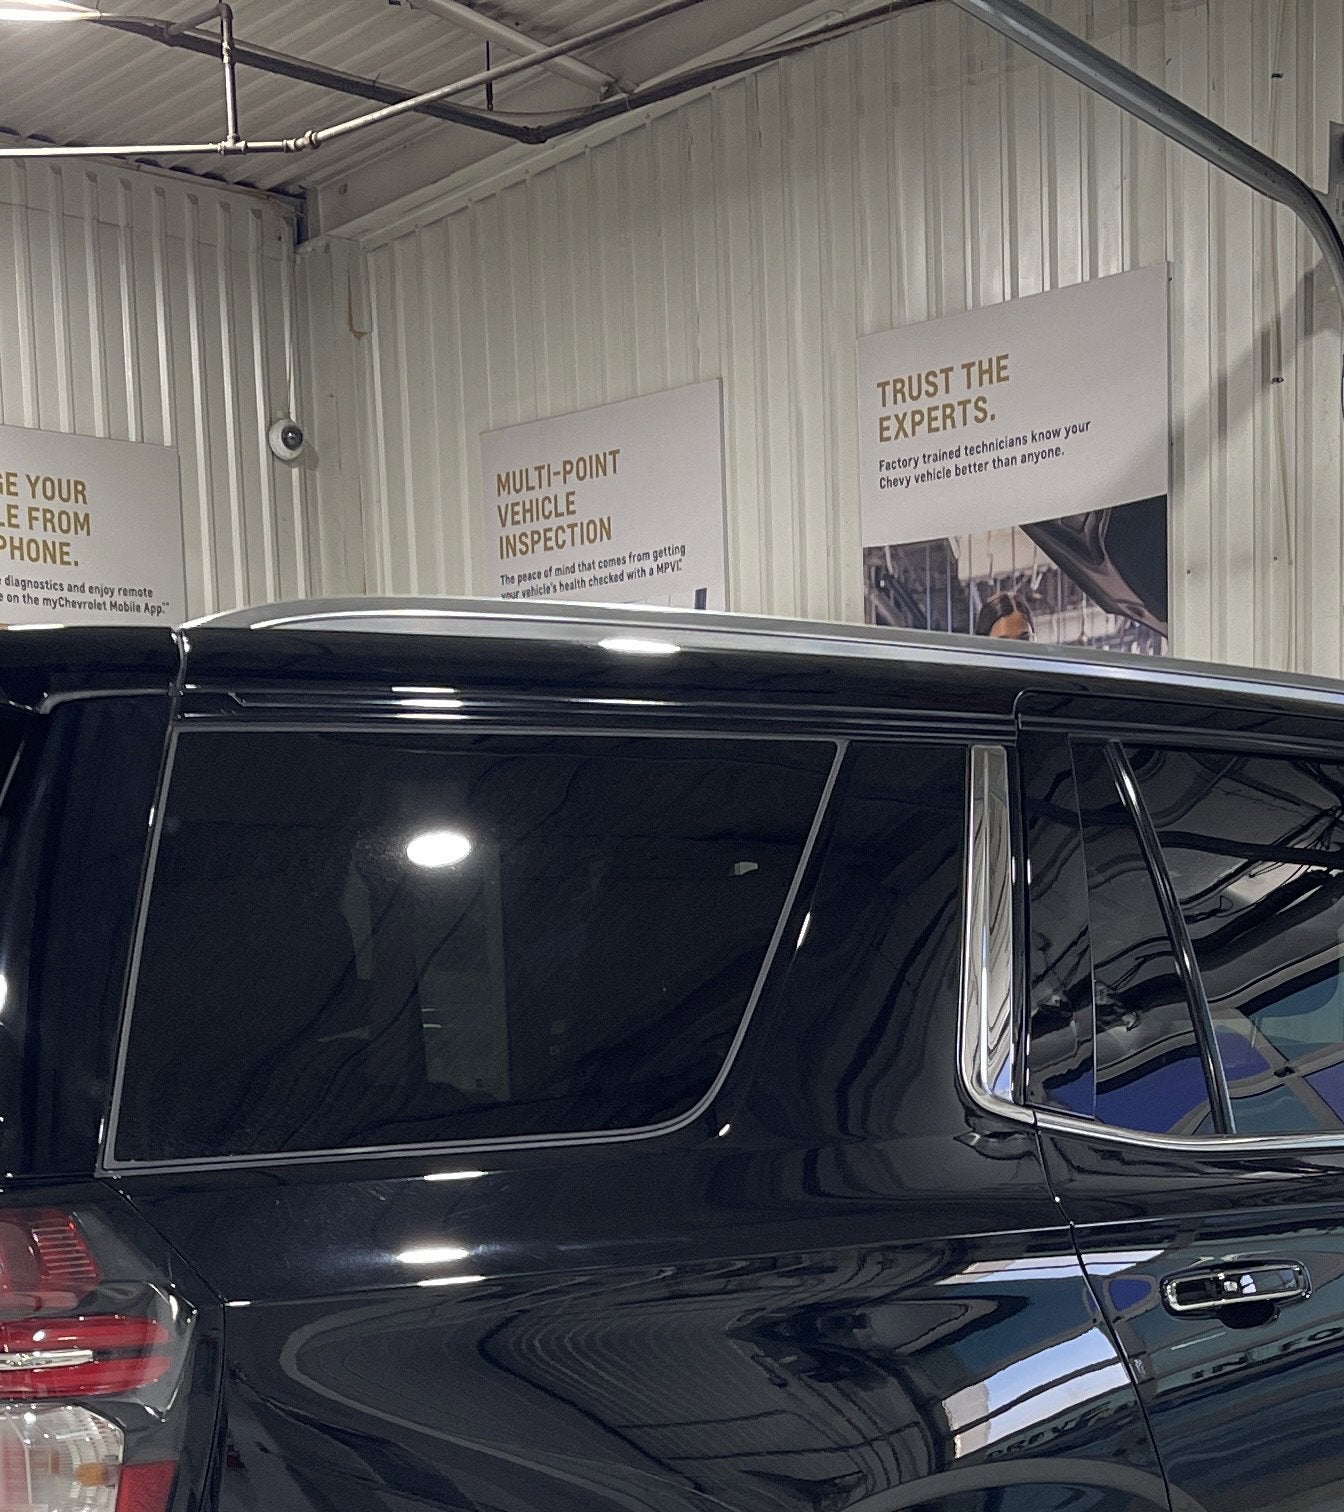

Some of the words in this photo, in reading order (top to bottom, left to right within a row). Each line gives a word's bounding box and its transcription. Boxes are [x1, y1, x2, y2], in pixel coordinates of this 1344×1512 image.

[877, 366, 954, 407] TRUST
[961, 353, 1009, 390] THE
[878, 395, 996, 443] EXPERTS.
[879, 456, 919, 472] Factory
[922, 445, 961, 464] trained
[964, 434, 1027, 456] technicians
[1031, 428, 1061, 443] know
[1064, 421, 1091, 439] your
[879, 475, 911, 489] Chevy
[914, 466, 952, 483] vehicle
[954, 461, 989, 477] better
[992, 455, 1017, 469] than
[1021, 446, 1064, 464] anyone.
[25, 474, 88, 504] YOUR
[496, 449, 620, 497] MULTI-POINT
[27, 506, 91, 536] FROM
[497, 490, 577, 528] VEHICLE
[499, 515, 612, 560] INSPECTION
[500, 574, 515, 585] The
[517, 570, 541, 586] peace
[543, 565, 552, 578] of
[555, 562, 575, 576] mind
[578, 559, 595, 572] that
[598, 555, 626, 569] comes
[628, 551, 650, 563] from
[652, 544, 685, 561] getting
[522, 581, 557, 598] vehicle's
[559, 577, 586, 592] health
[589, 570, 624, 587] checked
[626, 566, 646, 580] with
[648, 567, 654, 576] a
[4, 575, 64, 591] diagnostics
[67, 582, 85, 593] and
[88, 584, 115, 598] enjoy
[118, 587, 153, 598] remote
[7, 593, 19, 603] on
[22, 593, 39, 606] the
[42, 596, 107, 611] myChevrolet
[110, 600, 141, 613] Mobile
